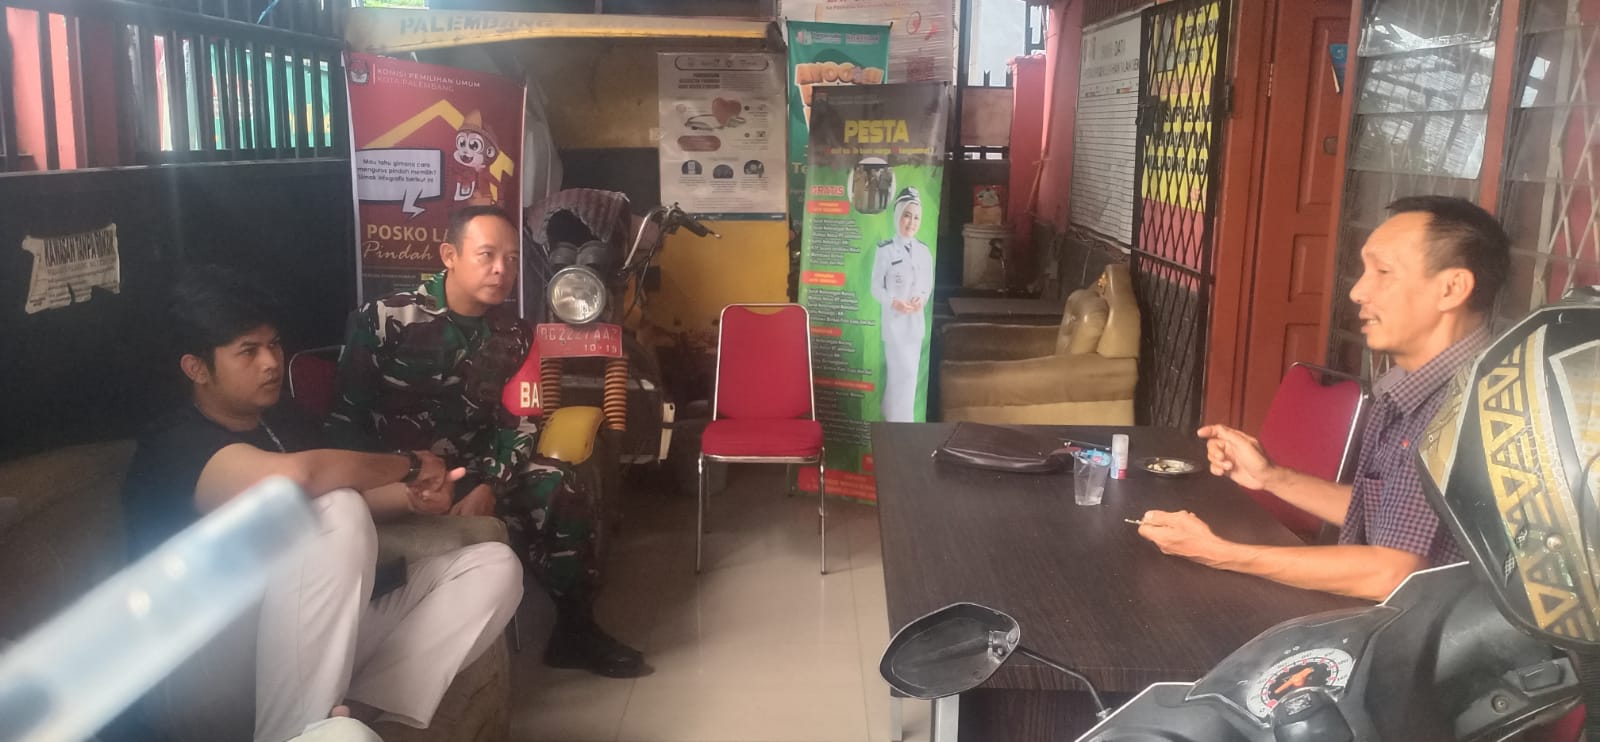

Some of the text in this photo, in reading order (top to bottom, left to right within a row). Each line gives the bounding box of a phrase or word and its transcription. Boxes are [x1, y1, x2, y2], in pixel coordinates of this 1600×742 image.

[378, 68, 481, 88] KOMISI PEMILIHAN UMUM
[844, 119, 910, 144] PESTA
[809, 185, 846, 196] GRATIS
[366, 224, 428, 242] POSKO
[363, 240, 433, 261] Pindah
[520, 381, 543, 409] BA
